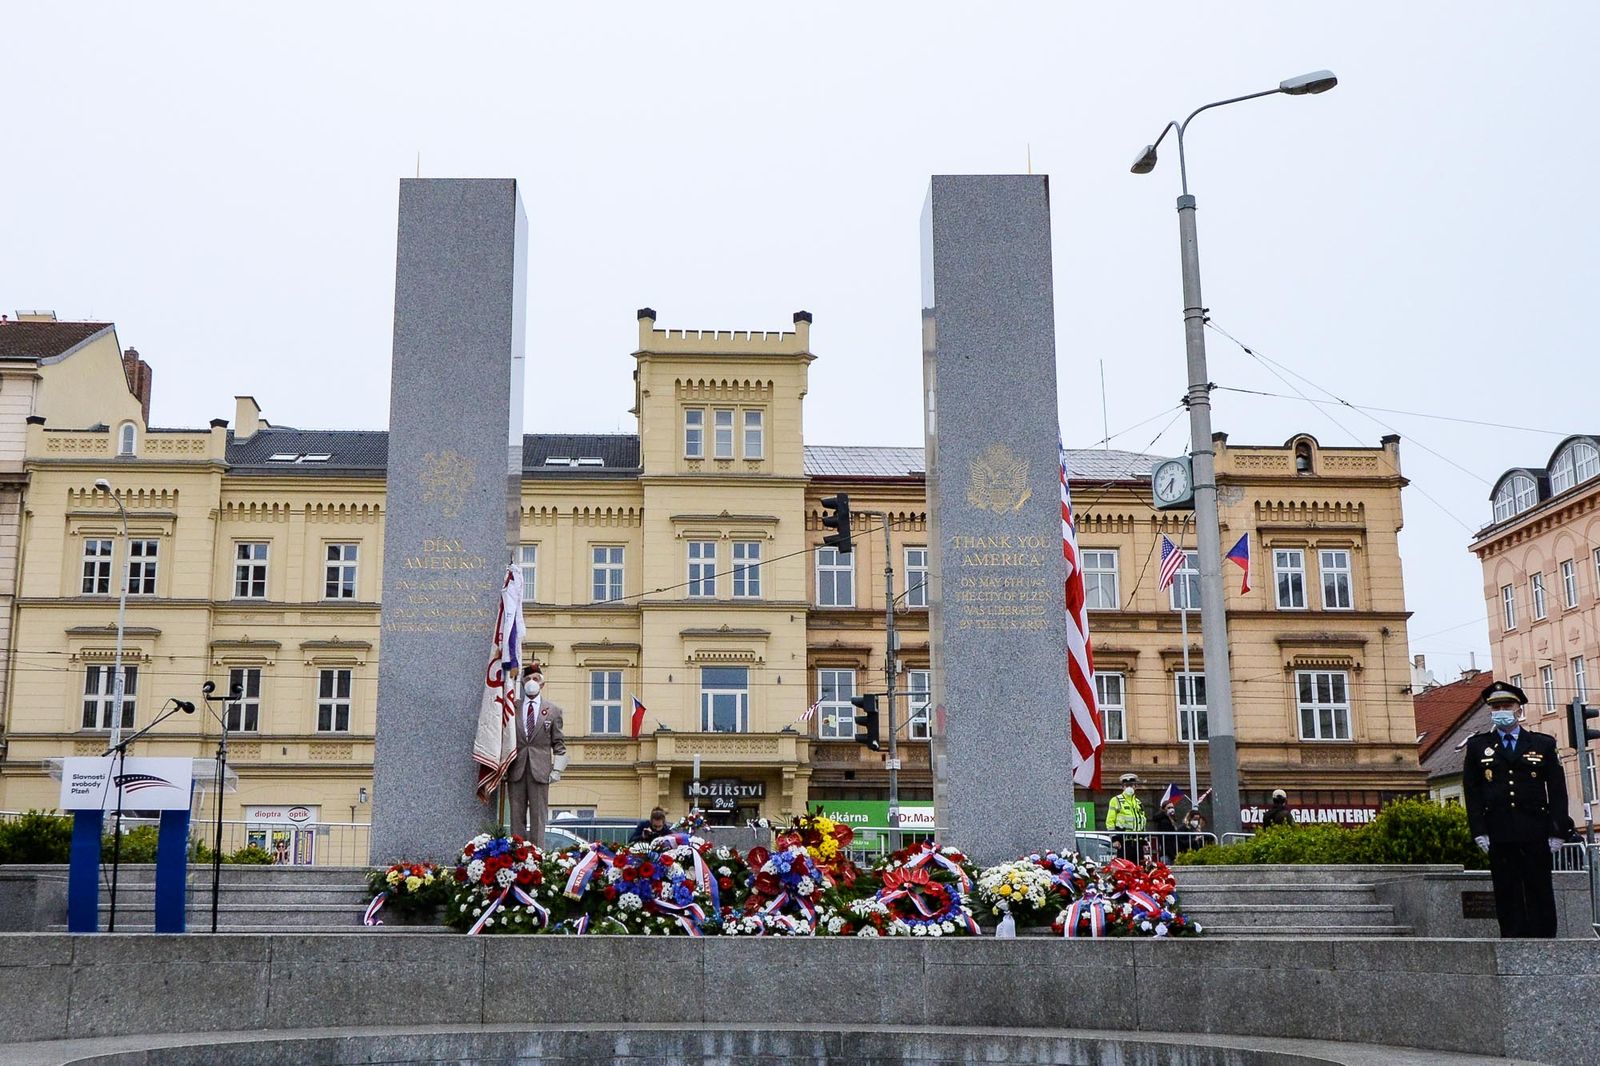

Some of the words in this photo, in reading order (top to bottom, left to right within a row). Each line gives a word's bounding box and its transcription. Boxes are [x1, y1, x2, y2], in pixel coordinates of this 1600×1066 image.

[952, 535, 1012, 549] THANK
[1018, 535, 1051, 549] YOU
[961, 552, 1045, 567] AMERICA!
[979, 577, 1001, 588] MAY
[978, 591, 1001, 602] CITY
[254, 810, 281, 818] dioptra
[289, 810, 308, 818] optik
[899, 813, 935, 823] Dr.Max
[1291, 808, 1377, 823] GALANTERIE
